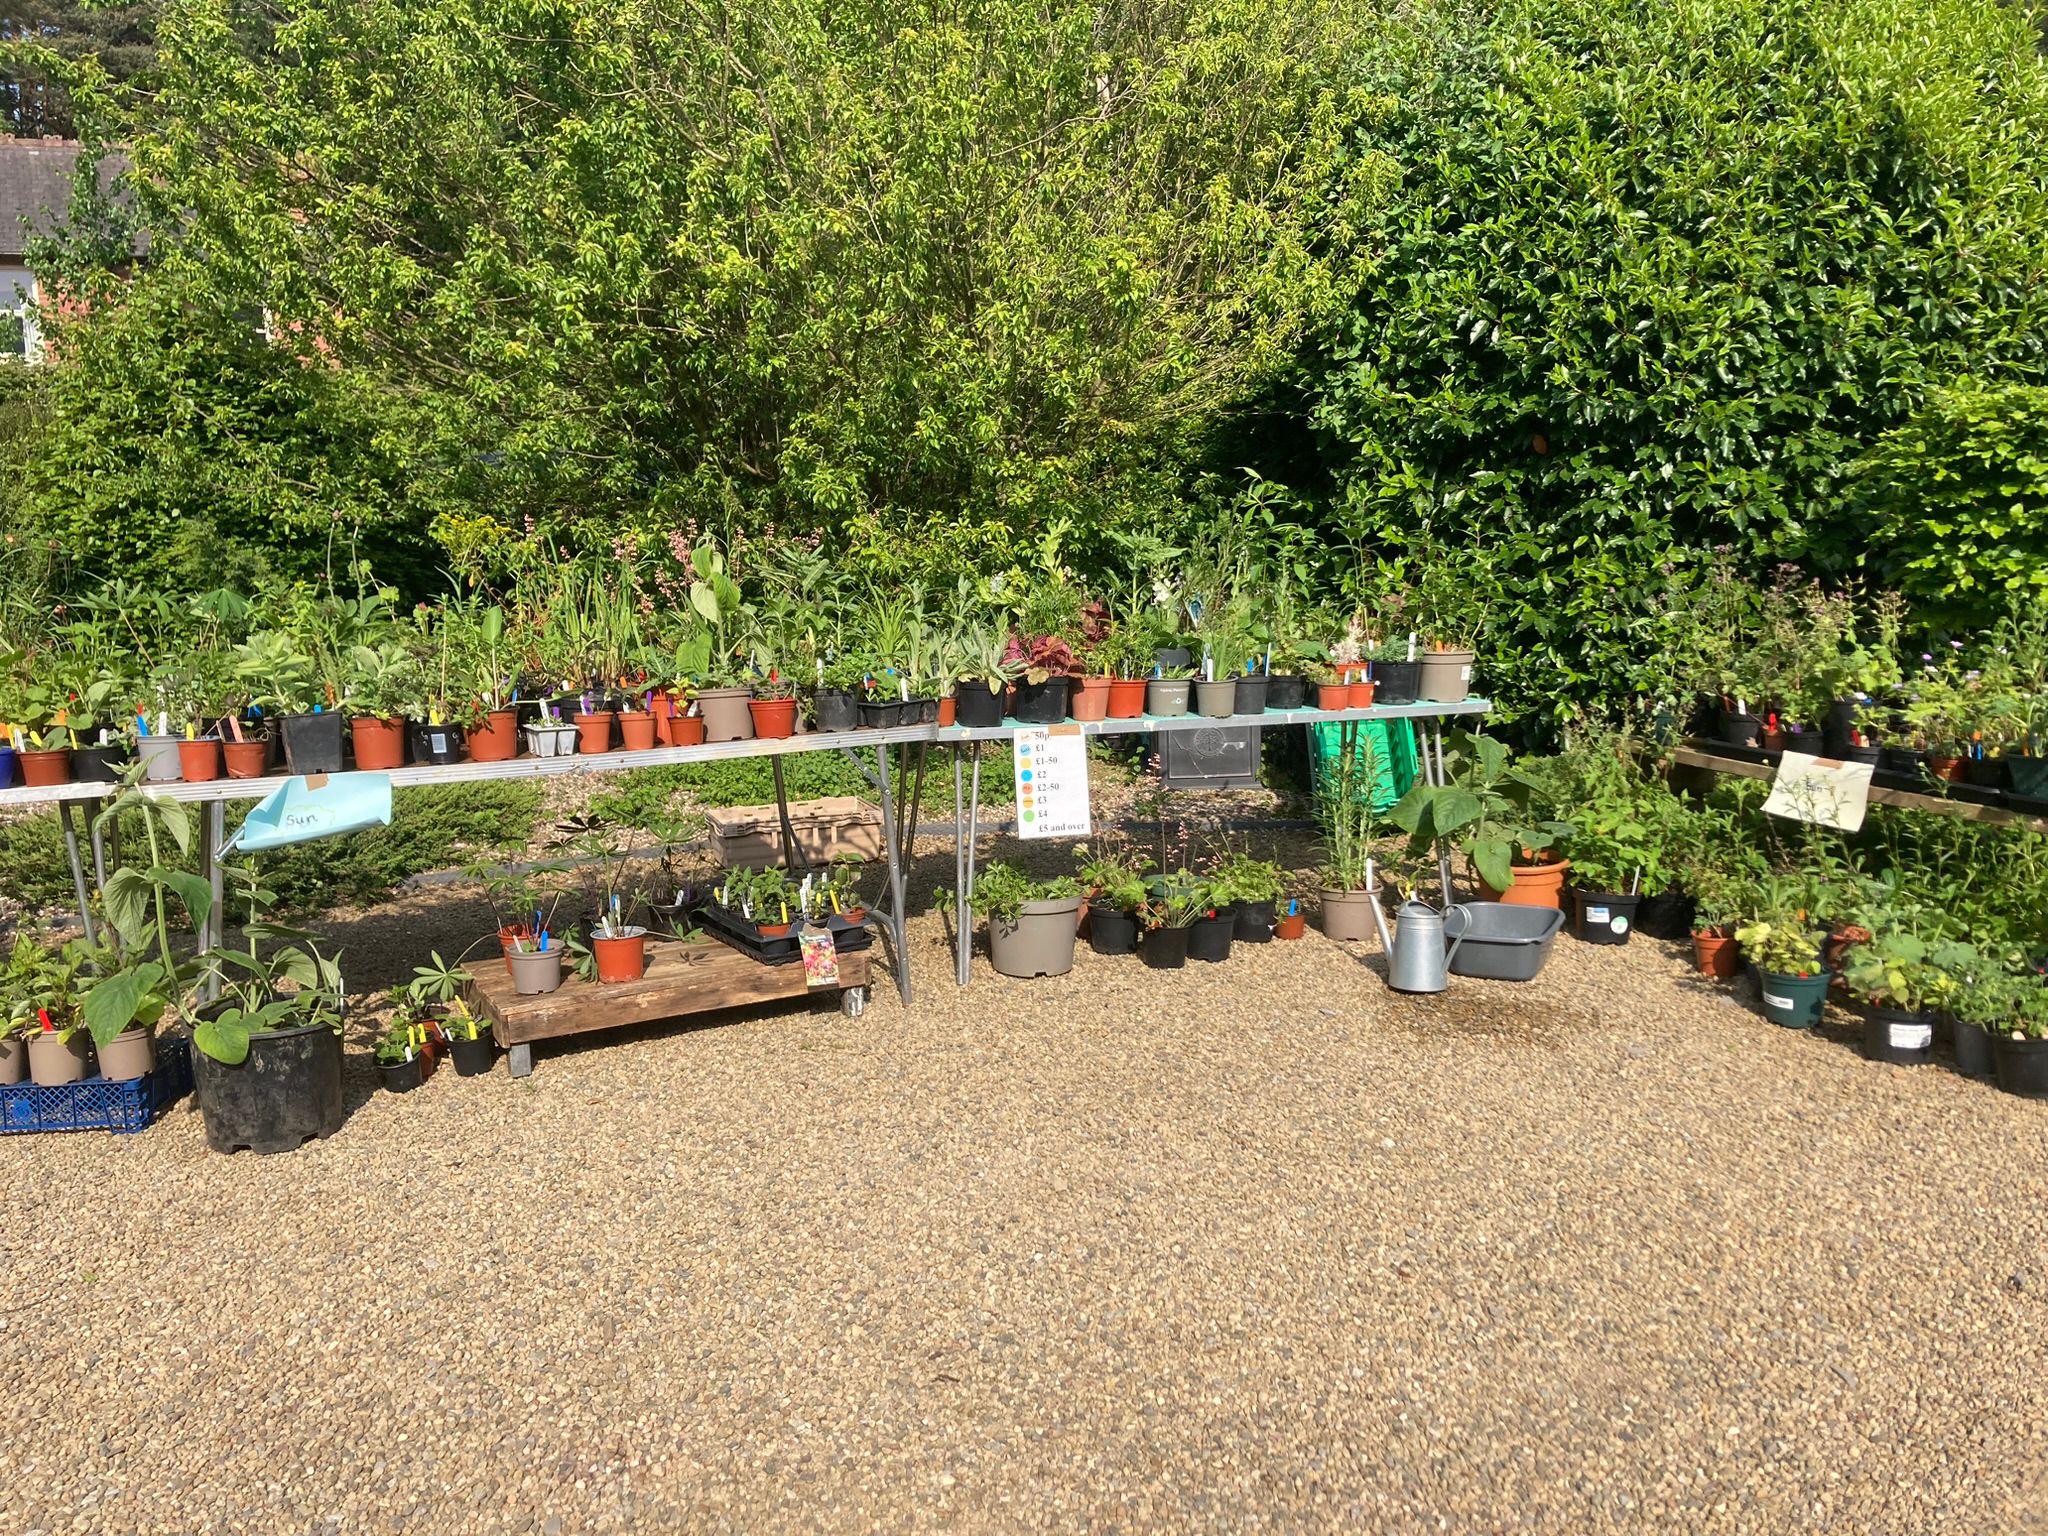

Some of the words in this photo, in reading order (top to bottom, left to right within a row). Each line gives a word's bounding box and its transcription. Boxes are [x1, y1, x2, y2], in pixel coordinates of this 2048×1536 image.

[1036, 744, 1044, 752] £1
[1036, 757, 1058, 765] £1-50
[1037, 770, 1047, 779] £2
[1037, 783, 1060, 792] £2-50
[1038, 796, 1047, 804] £3
[1038, 810, 1048, 818] £4
[286, 814, 318, 826] Sun
[1039, 824, 1049, 833] £5
[1050, 823, 1066, 832] and
[1067, 823, 1085, 831] over
